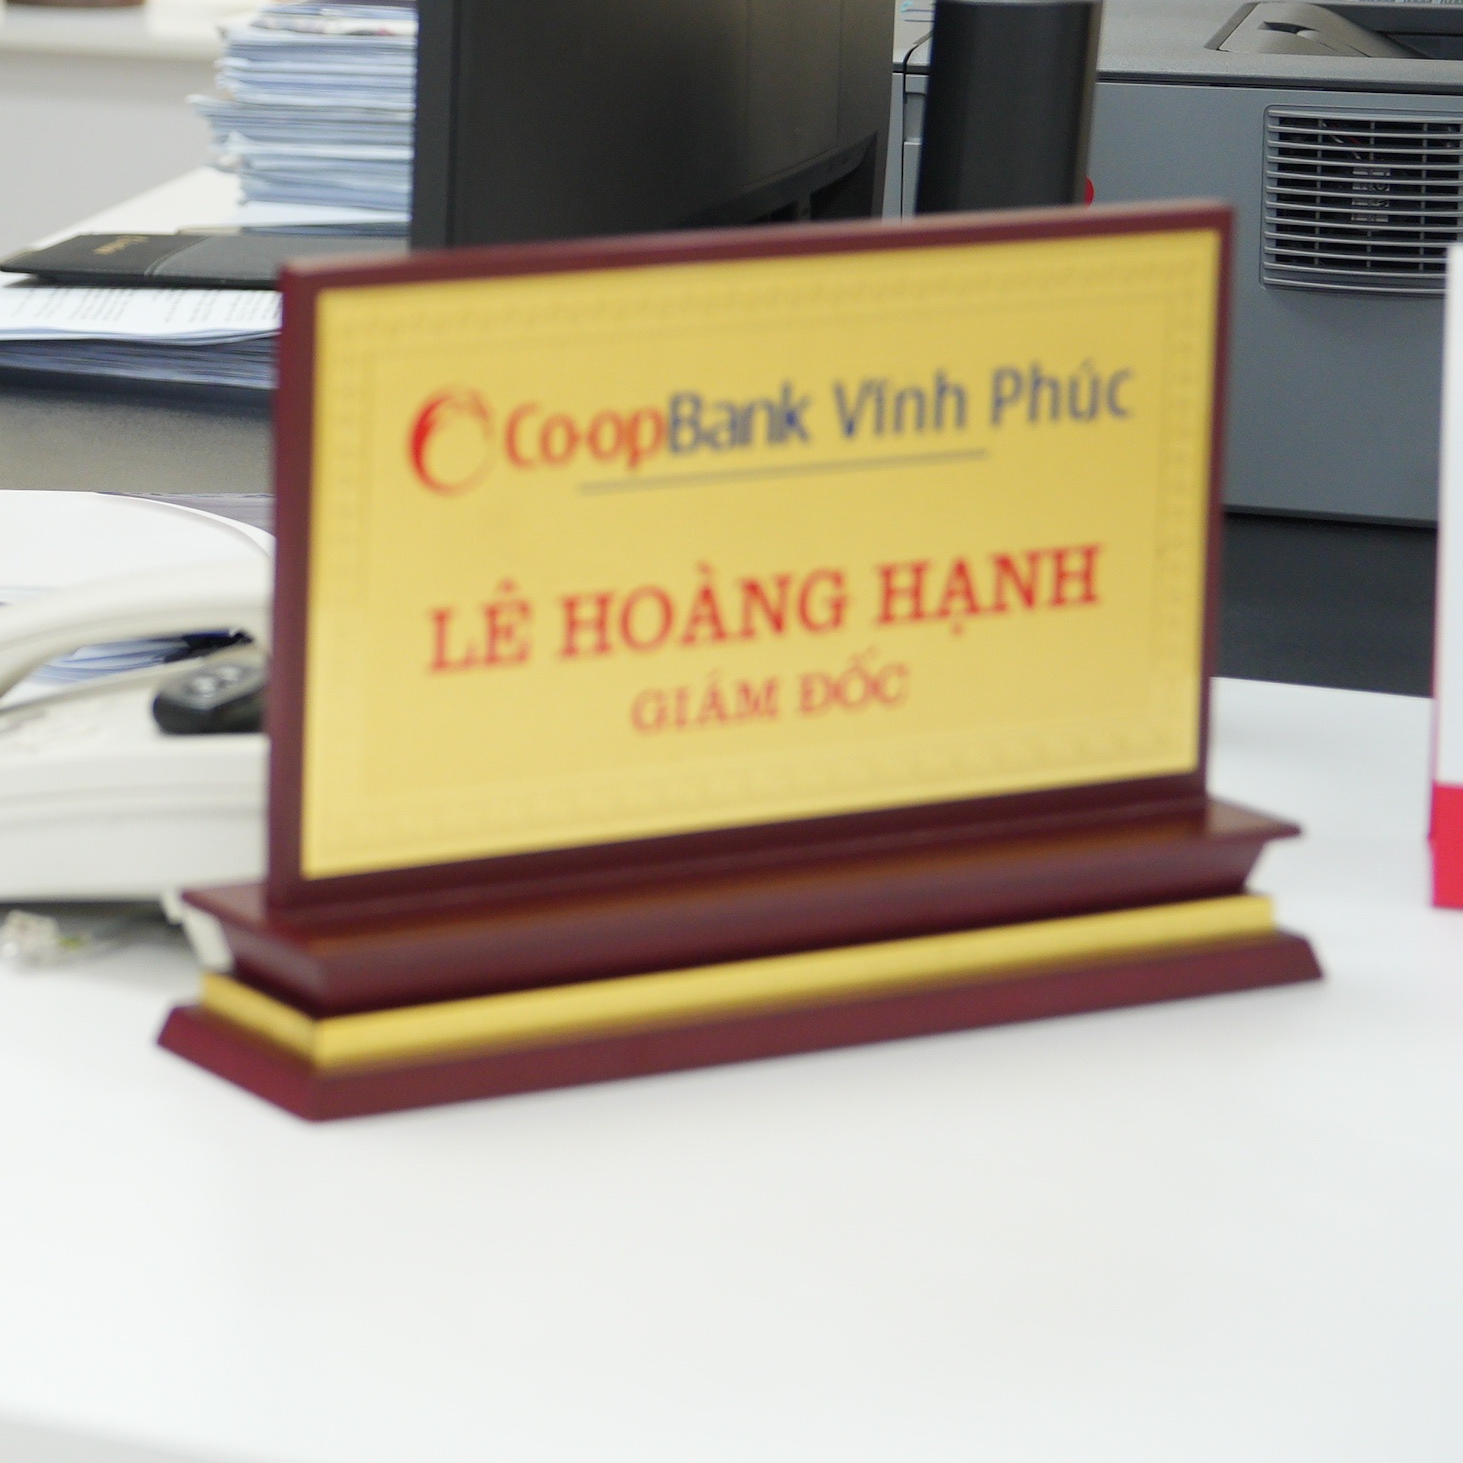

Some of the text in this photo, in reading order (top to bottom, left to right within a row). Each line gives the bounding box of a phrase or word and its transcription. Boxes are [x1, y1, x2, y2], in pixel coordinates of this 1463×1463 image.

[989, 356, 1135, 430] Phúc
[428, 542, 1102, 676] LÊ HOÀNG HẠNH
[629, 643, 910, 737] GIÁM ĐỐC
